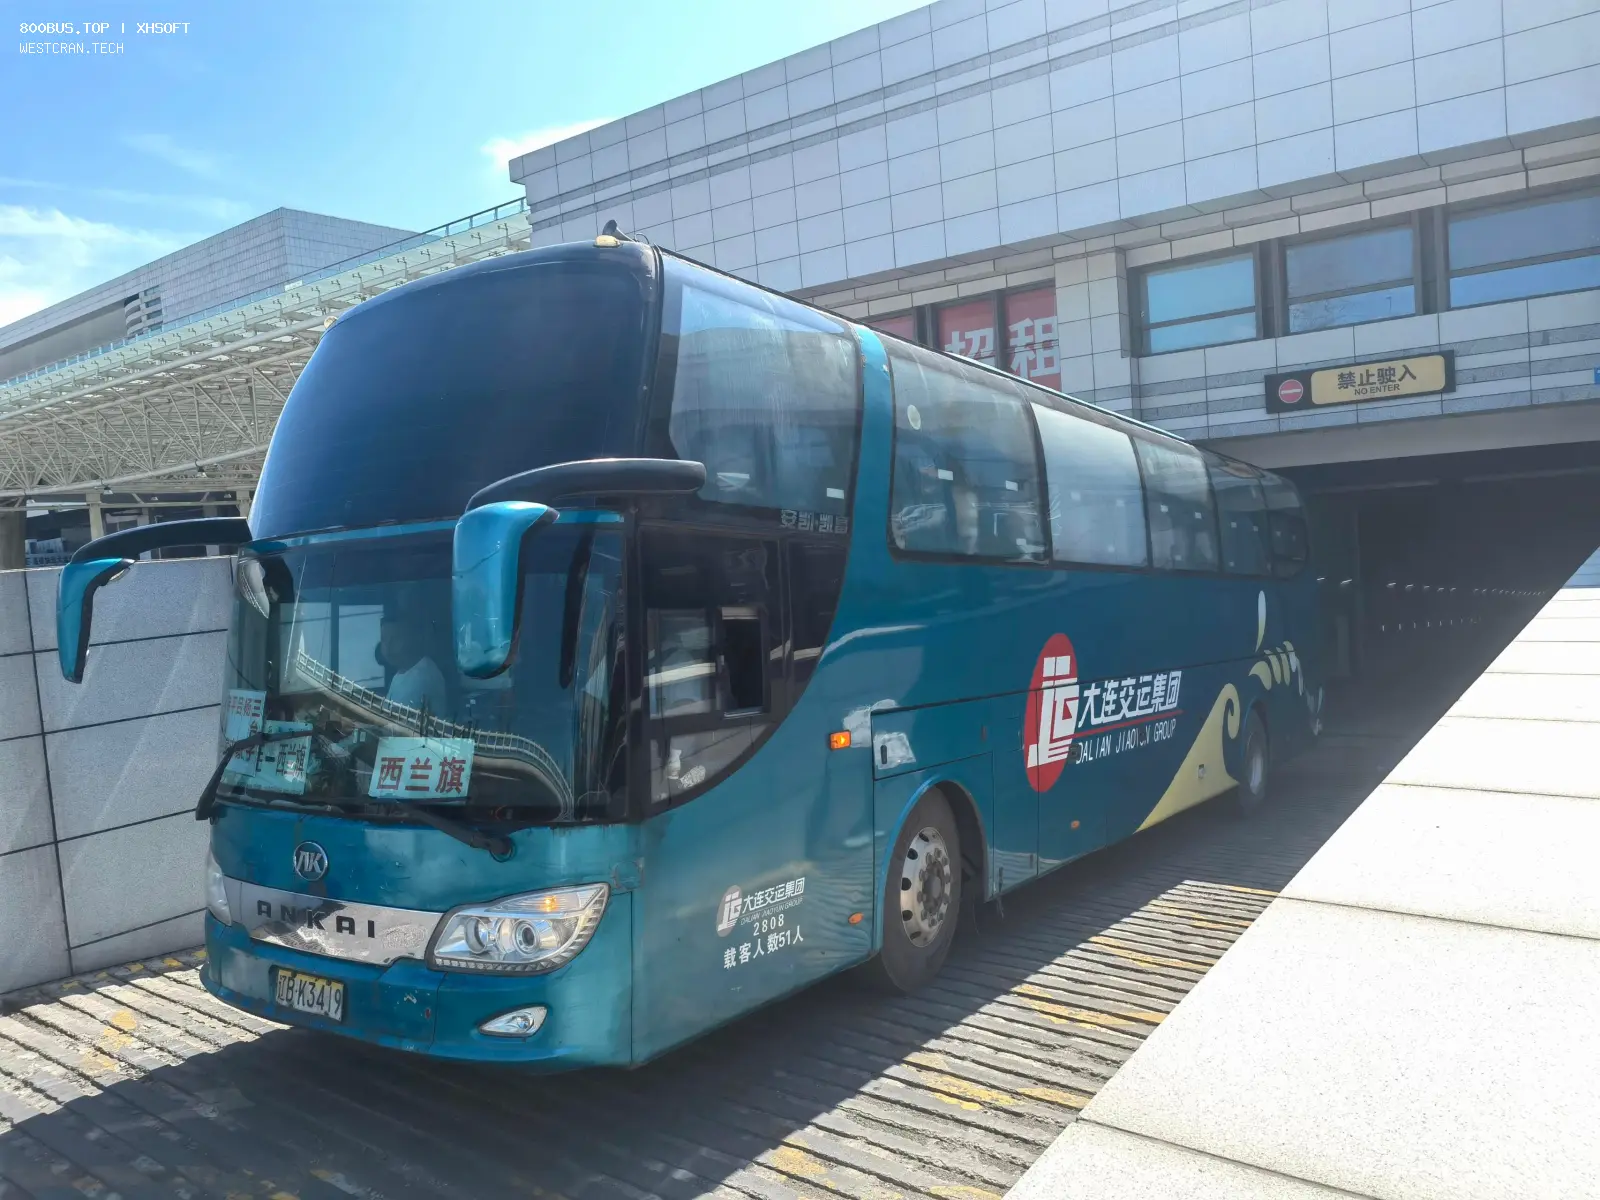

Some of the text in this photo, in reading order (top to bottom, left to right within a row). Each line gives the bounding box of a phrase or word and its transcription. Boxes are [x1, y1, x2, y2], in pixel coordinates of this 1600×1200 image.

[945, 316, 1061, 378] 招租
[1337, 364, 1417, 390] 禁止驶入
[1354, 383, 1400, 396] NO ENTER
[1078, 670, 1182, 728] 大连交运集团
[1075, 734, 1112, 765] DALIAN
[1153, 718, 1177, 743] GROUP
[376, 756, 467, 794] 西兰旗
[742, 877, 806, 914] 大连交运集团
[257, 900, 376, 939] ANKAI
[753, 913, 785, 936] 2808
[723, 925, 804, 969] 载客人数51人
